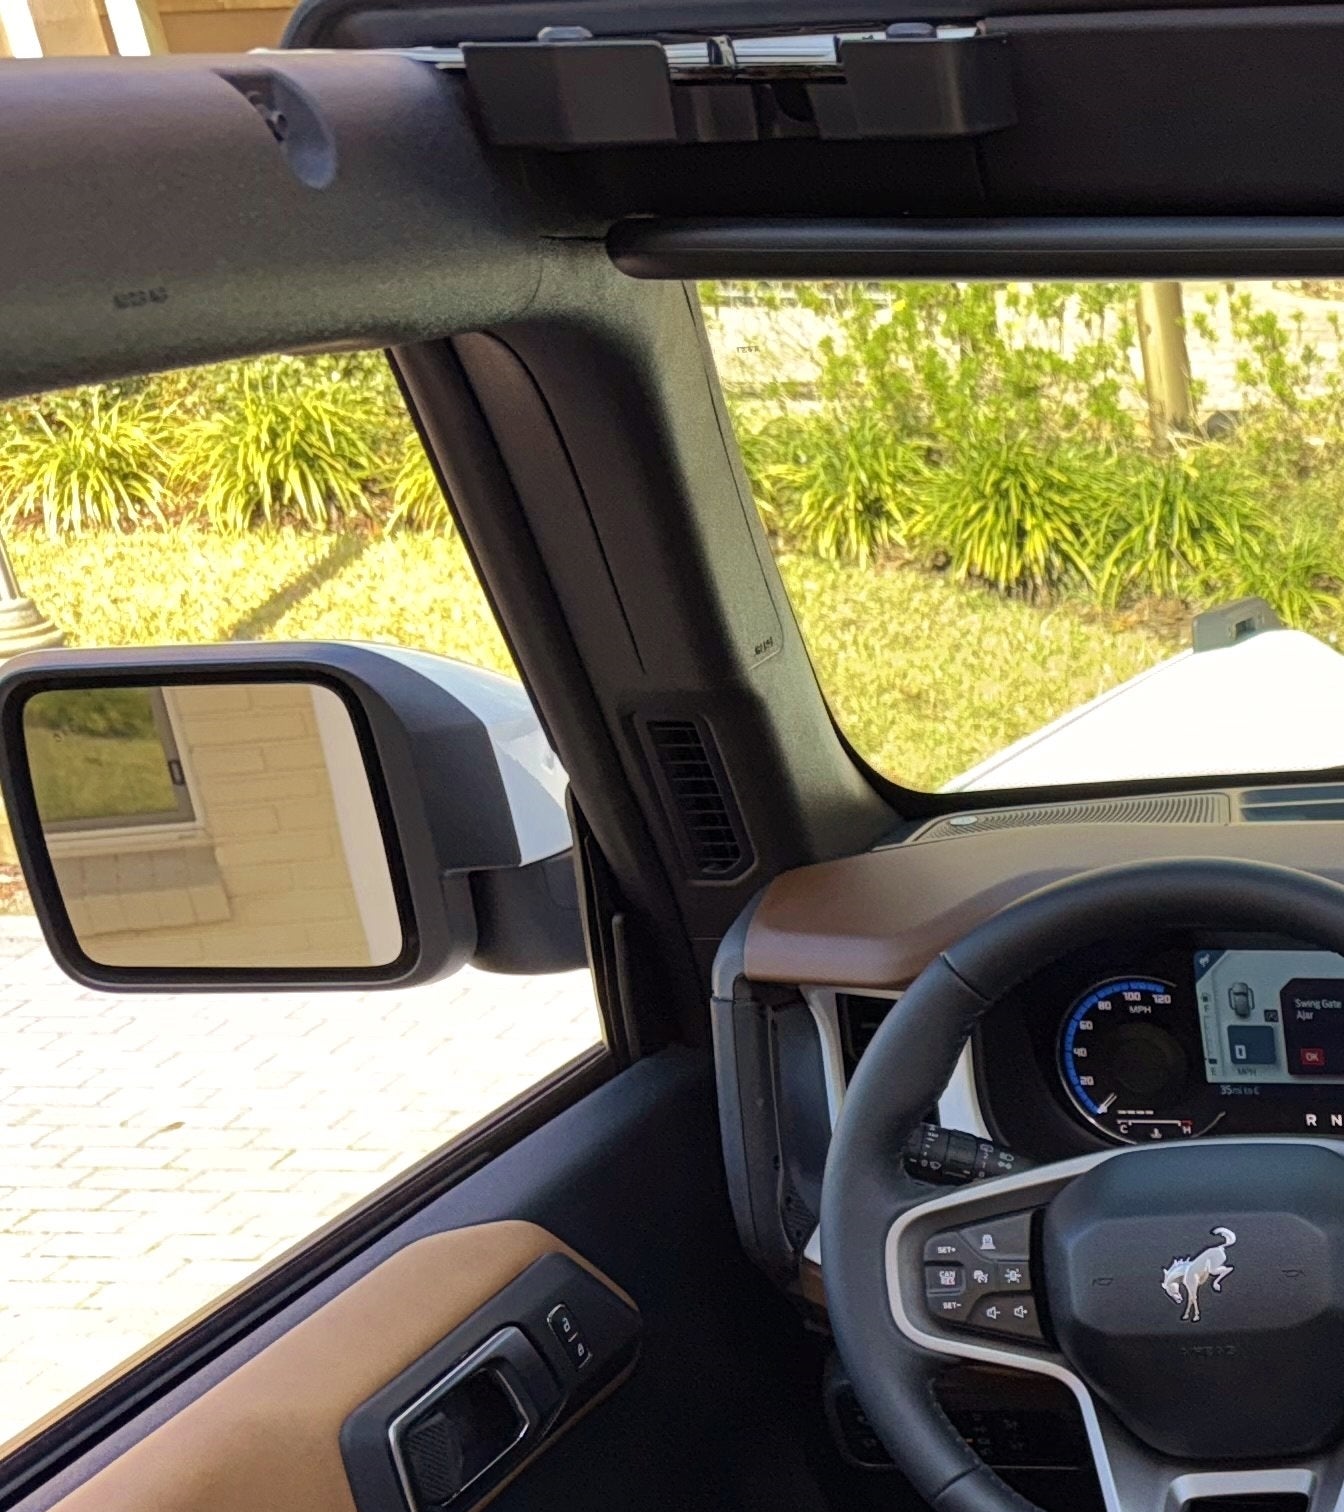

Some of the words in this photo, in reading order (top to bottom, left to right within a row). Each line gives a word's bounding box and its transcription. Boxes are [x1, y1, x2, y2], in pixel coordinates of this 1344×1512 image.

[1122, 991, 1142, 1001] 100
[1152, 994, 1172, 1004] 120
[1129, 1005, 1152, 1014] MPH
[1073, 1047, 1088, 1057] 40
[1305, 1113, 1317, 1127] R
[1330, 1114, 1343, 1127] N
